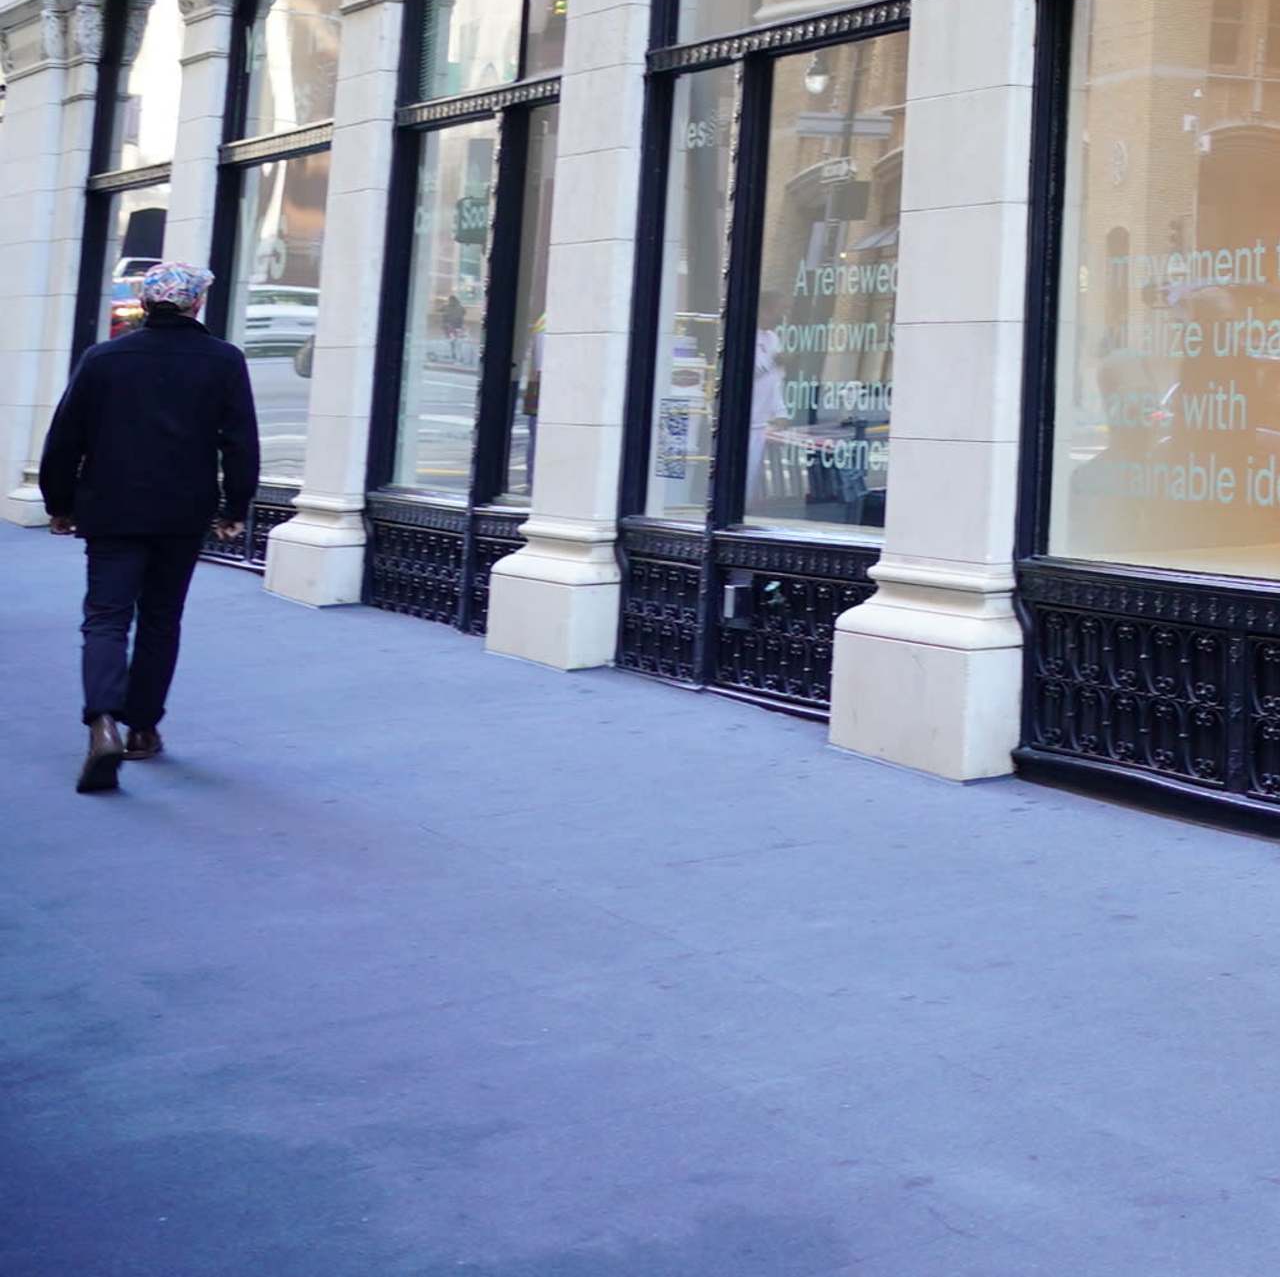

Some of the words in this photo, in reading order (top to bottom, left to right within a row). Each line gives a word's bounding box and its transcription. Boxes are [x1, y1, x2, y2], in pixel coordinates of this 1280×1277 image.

[793, 260, 808, 296] A
[1106, 237, 1265, 284] vement
[775, 315, 878, 354] downtown
[779, 369, 819, 420] ght
[1183, 379, 1247, 430] with
